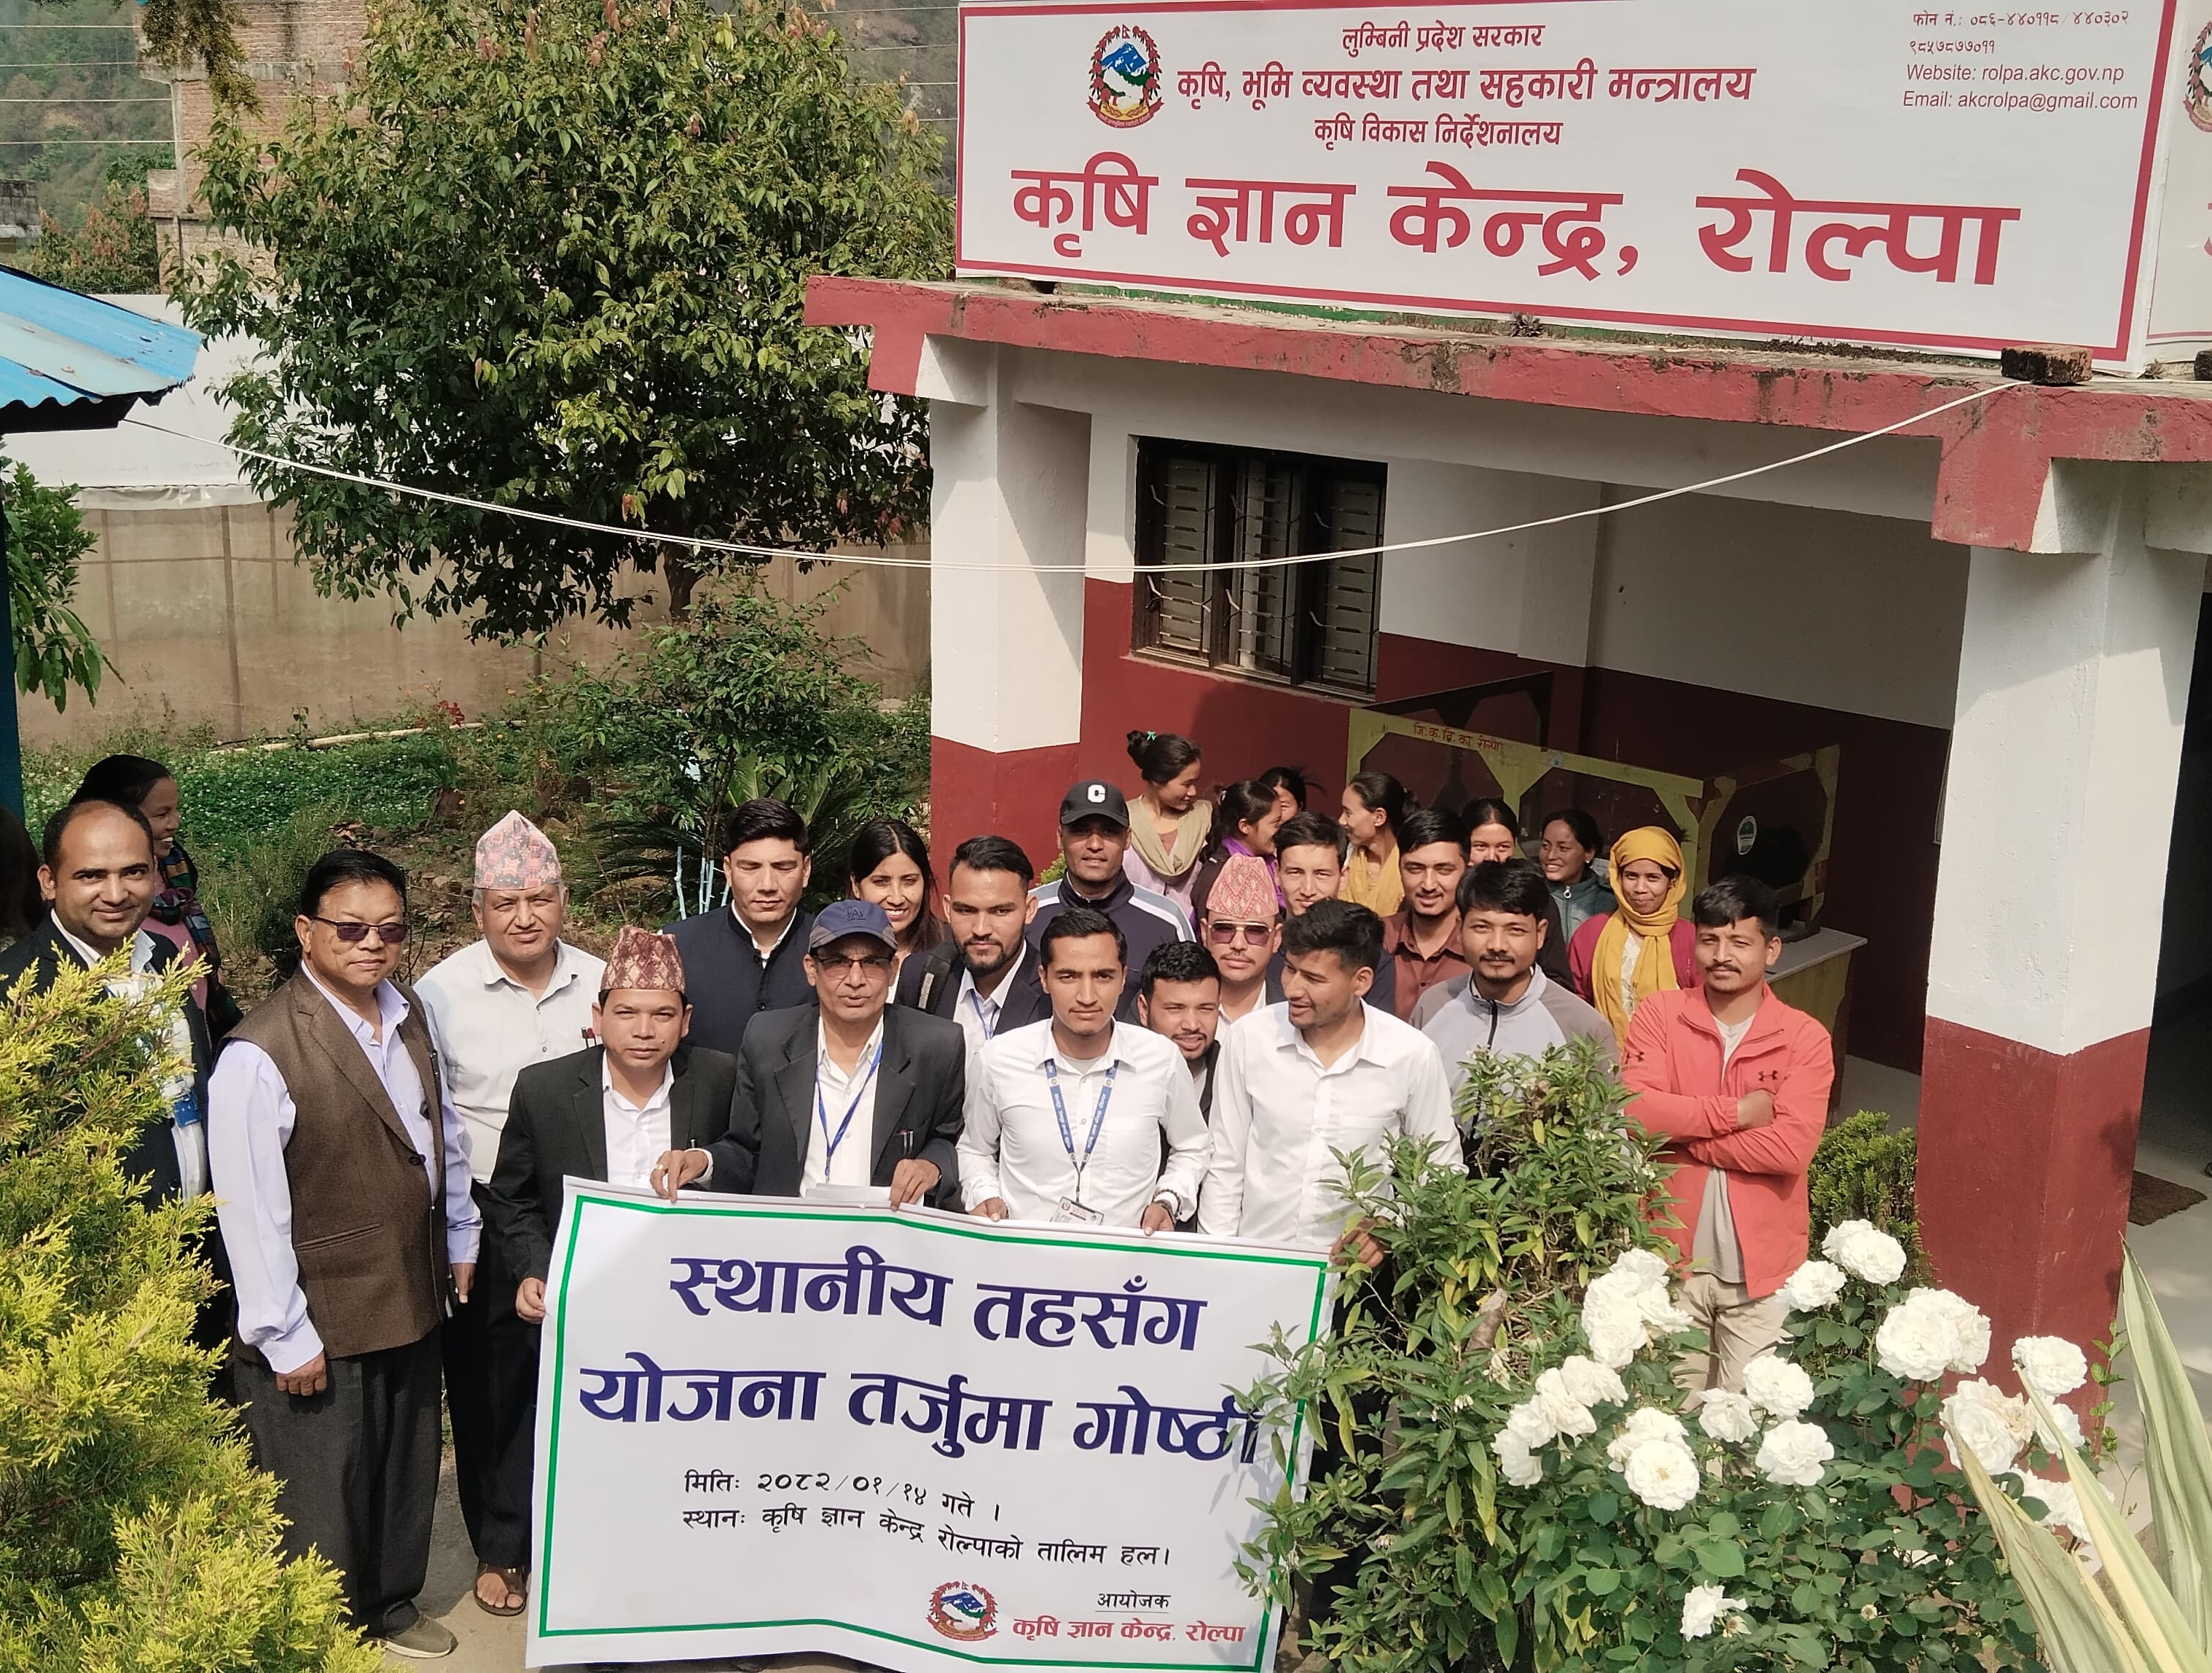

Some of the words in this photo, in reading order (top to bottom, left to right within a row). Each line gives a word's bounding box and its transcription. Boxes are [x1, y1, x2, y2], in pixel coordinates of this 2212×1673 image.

[1913, 10, 1939, 27] फोन
[1343, 20, 1411, 58] लुम्बिनी
[1416, 20, 1464, 52] प्रदेश
[1472, 24, 1545, 47] सरकार
[1177, 61, 1231, 110] कृषि,
[1243, 60, 1294, 111] भूमि
[1301, 69, 1403, 100] व्यवस्था
[1412, 69, 1470, 101] तथा
[1480, 57, 1599, 109] सहकारी
[1609, 67, 1757, 103] मन्त्रालय
[1907, 64, 1977, 81] Website:
[1982, 64, 2125, 85] rolpa.akc.gov.np
[1902, 91, 1953, 107] Email:
[1958, 91, 2138, 112] akcrolpa@gmail.com
[1314, 111, 1355, 151] कृषि
[1362, 111, 1428, 144] विकास
[1435, 112, 1564, 149] निर्देशनालय
[1011, 151, 1160, 259] कृषि
[1185, 177, 1357, 257] ज्ञान
[1387, 160, 1639, 281] केन्द्र,
[1695, 168, 2021, 286] रोल्पा
[1087, 784, 1106, 803] C
[671, 1245, 951, 1325] स्थानीय
[975, 1274, 1206, 1350] तहसँग
[579, 1352, 825, 1422] योजना
[850, 1374, 1051, 1457] तर्जुमा
[1074, 1386, 1266, 1464] गोष्ठी
[757, 1472, 927, 1506] २०८२/०१/१४
[941, 1490, 976, 1519] गते
[761, 1502, 808, 1534] कृषि
[821, 1506, 866, 1529] ज्ञान
[879, 1508, 925, 1544] केन्द्र
[938, 1523, 1024, 1561] रोल्पाको
[1037, 1538, 1108, 1564] तालिम
[1095, 1590, 1172, 1610] आयोजक
[1011, 1614, 1060, 1641] कृषि
[1067, 1620, 1114, 1639] ज्ञान
[1185, 1619, 1246, 1643] रोल्पा
